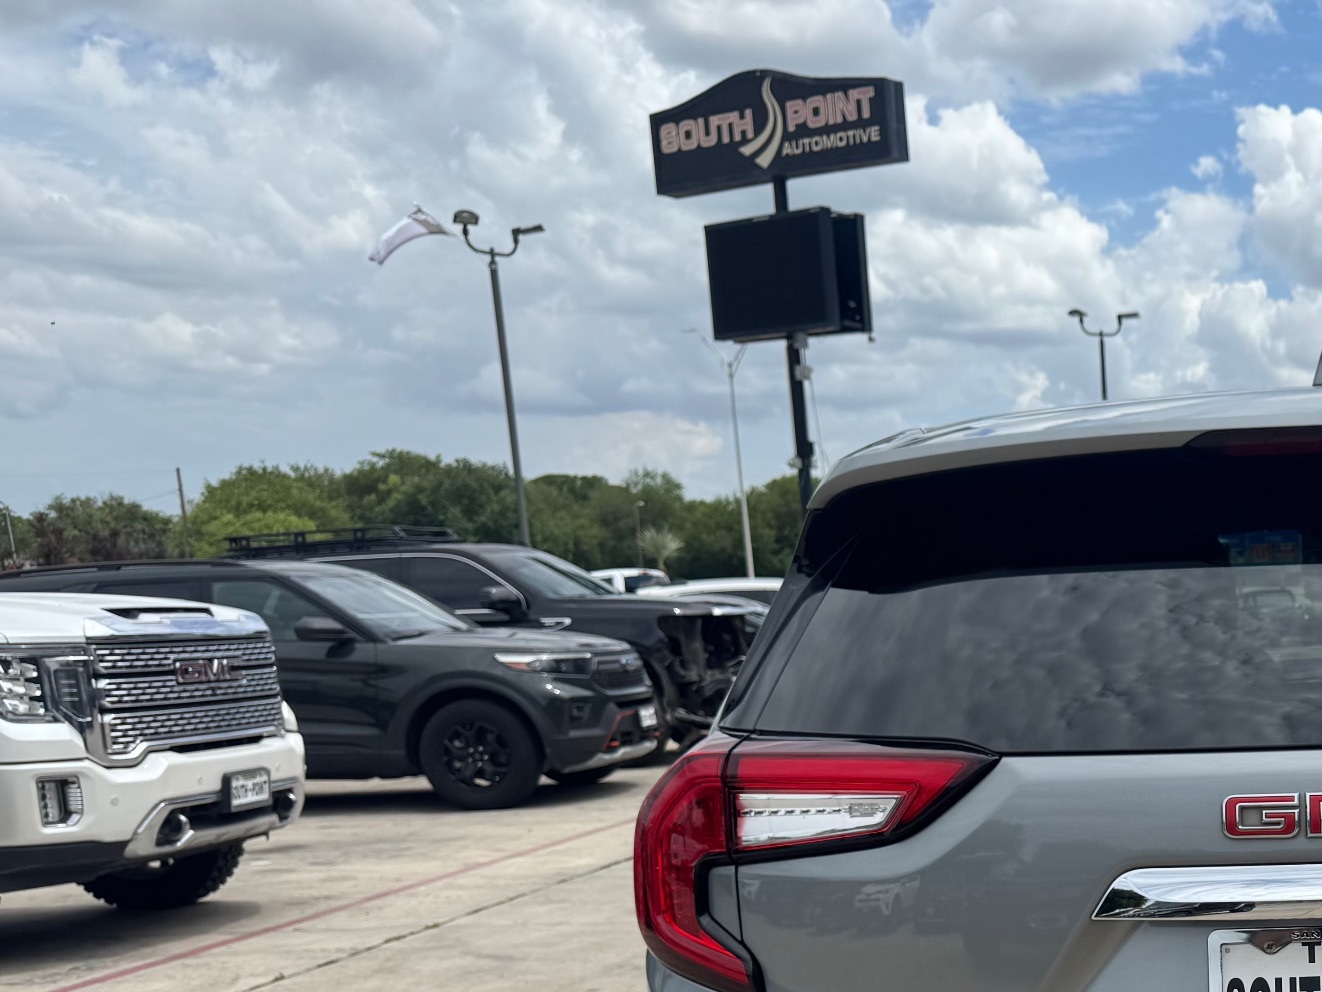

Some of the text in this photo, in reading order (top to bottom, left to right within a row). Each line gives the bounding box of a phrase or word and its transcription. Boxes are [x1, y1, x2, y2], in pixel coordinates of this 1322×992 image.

[660, 86, 875, 154] SOUTH POINT
[781, 125, 881, 157] AUTOMOTIVE
[1291, 929, 1321, 939] SAN
